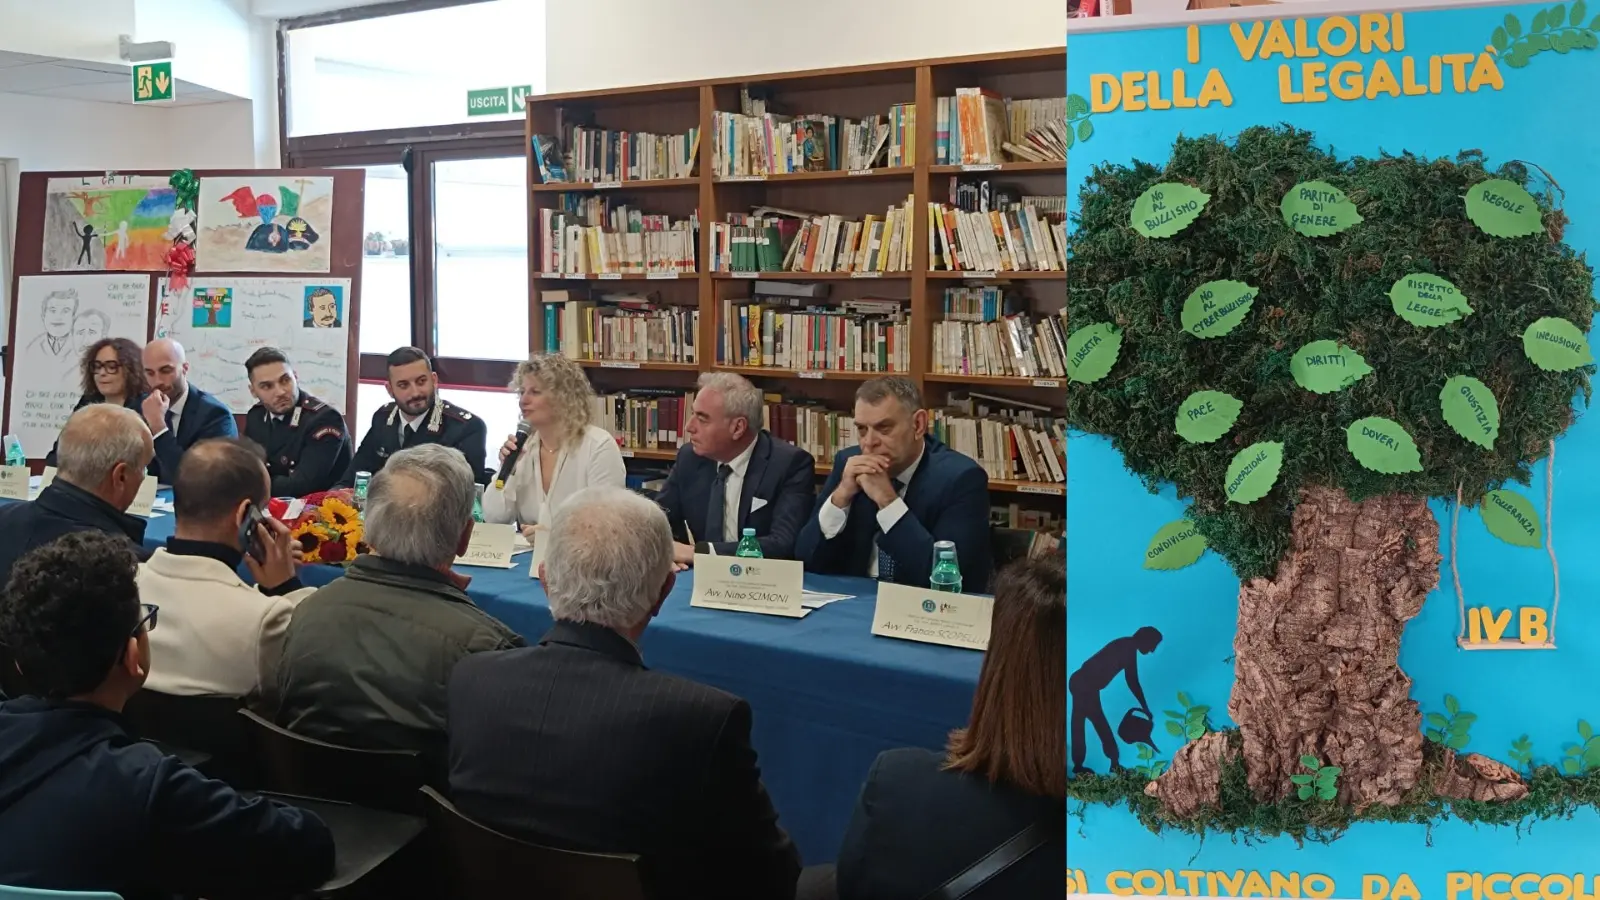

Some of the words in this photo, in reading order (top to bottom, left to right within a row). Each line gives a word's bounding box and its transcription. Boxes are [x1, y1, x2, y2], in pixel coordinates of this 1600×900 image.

[1187, 24, 1200, 64] I
[1230, 12, 1405, 61] VALORI
[1090, 68, 1234, 113] DELLA
[1278, 45, 1504, 104] LEGALITÀ
[470, 95, 506, 109] USCITA
[1151, 190, 1164, 203] NO
[1152, 201, 1166, 213] AL
[1313, 202, 1323, 212] DI
[1482, 190, 1525, 214] REGOLE
[1144, 200, 1198, 231] BULLISMO
[1292, 212, 1337, 227] GENERE
[1200, 290, 1214, 303] NO
[1407, 279, 1454, 295] RISPETTO
[1192, 292, 1253, 333] CYBERBULLISMO
[1203, 301, 1216, 312] AL
[1406, 301, 1446, 317] LEGGE
[1536, 331, 1582, 353] INCLUSIONE
[1305, 354, 1346, 367] DIRITTI
[1187, 401, 1215, 421] PACE
[1460, 386, 1493, 436] GIUSTIZIA
[1362, 426, 1400, 452] DOVERI
[1227, 450, 1268, 495] EDUCAZIONE
[1492, 493, 1536, 537] TOLLERANZA
[1147, 527, 1200, 559] CONDIVISION
[748, 591, 789, 604] SCIMONI
[1468, 606, 1513, 645] IV
[1520, 606, 1549, 645] B
[1105, 868, 1335, 899] COLTIVANO
[1362, 873, 1422, 900] DA
